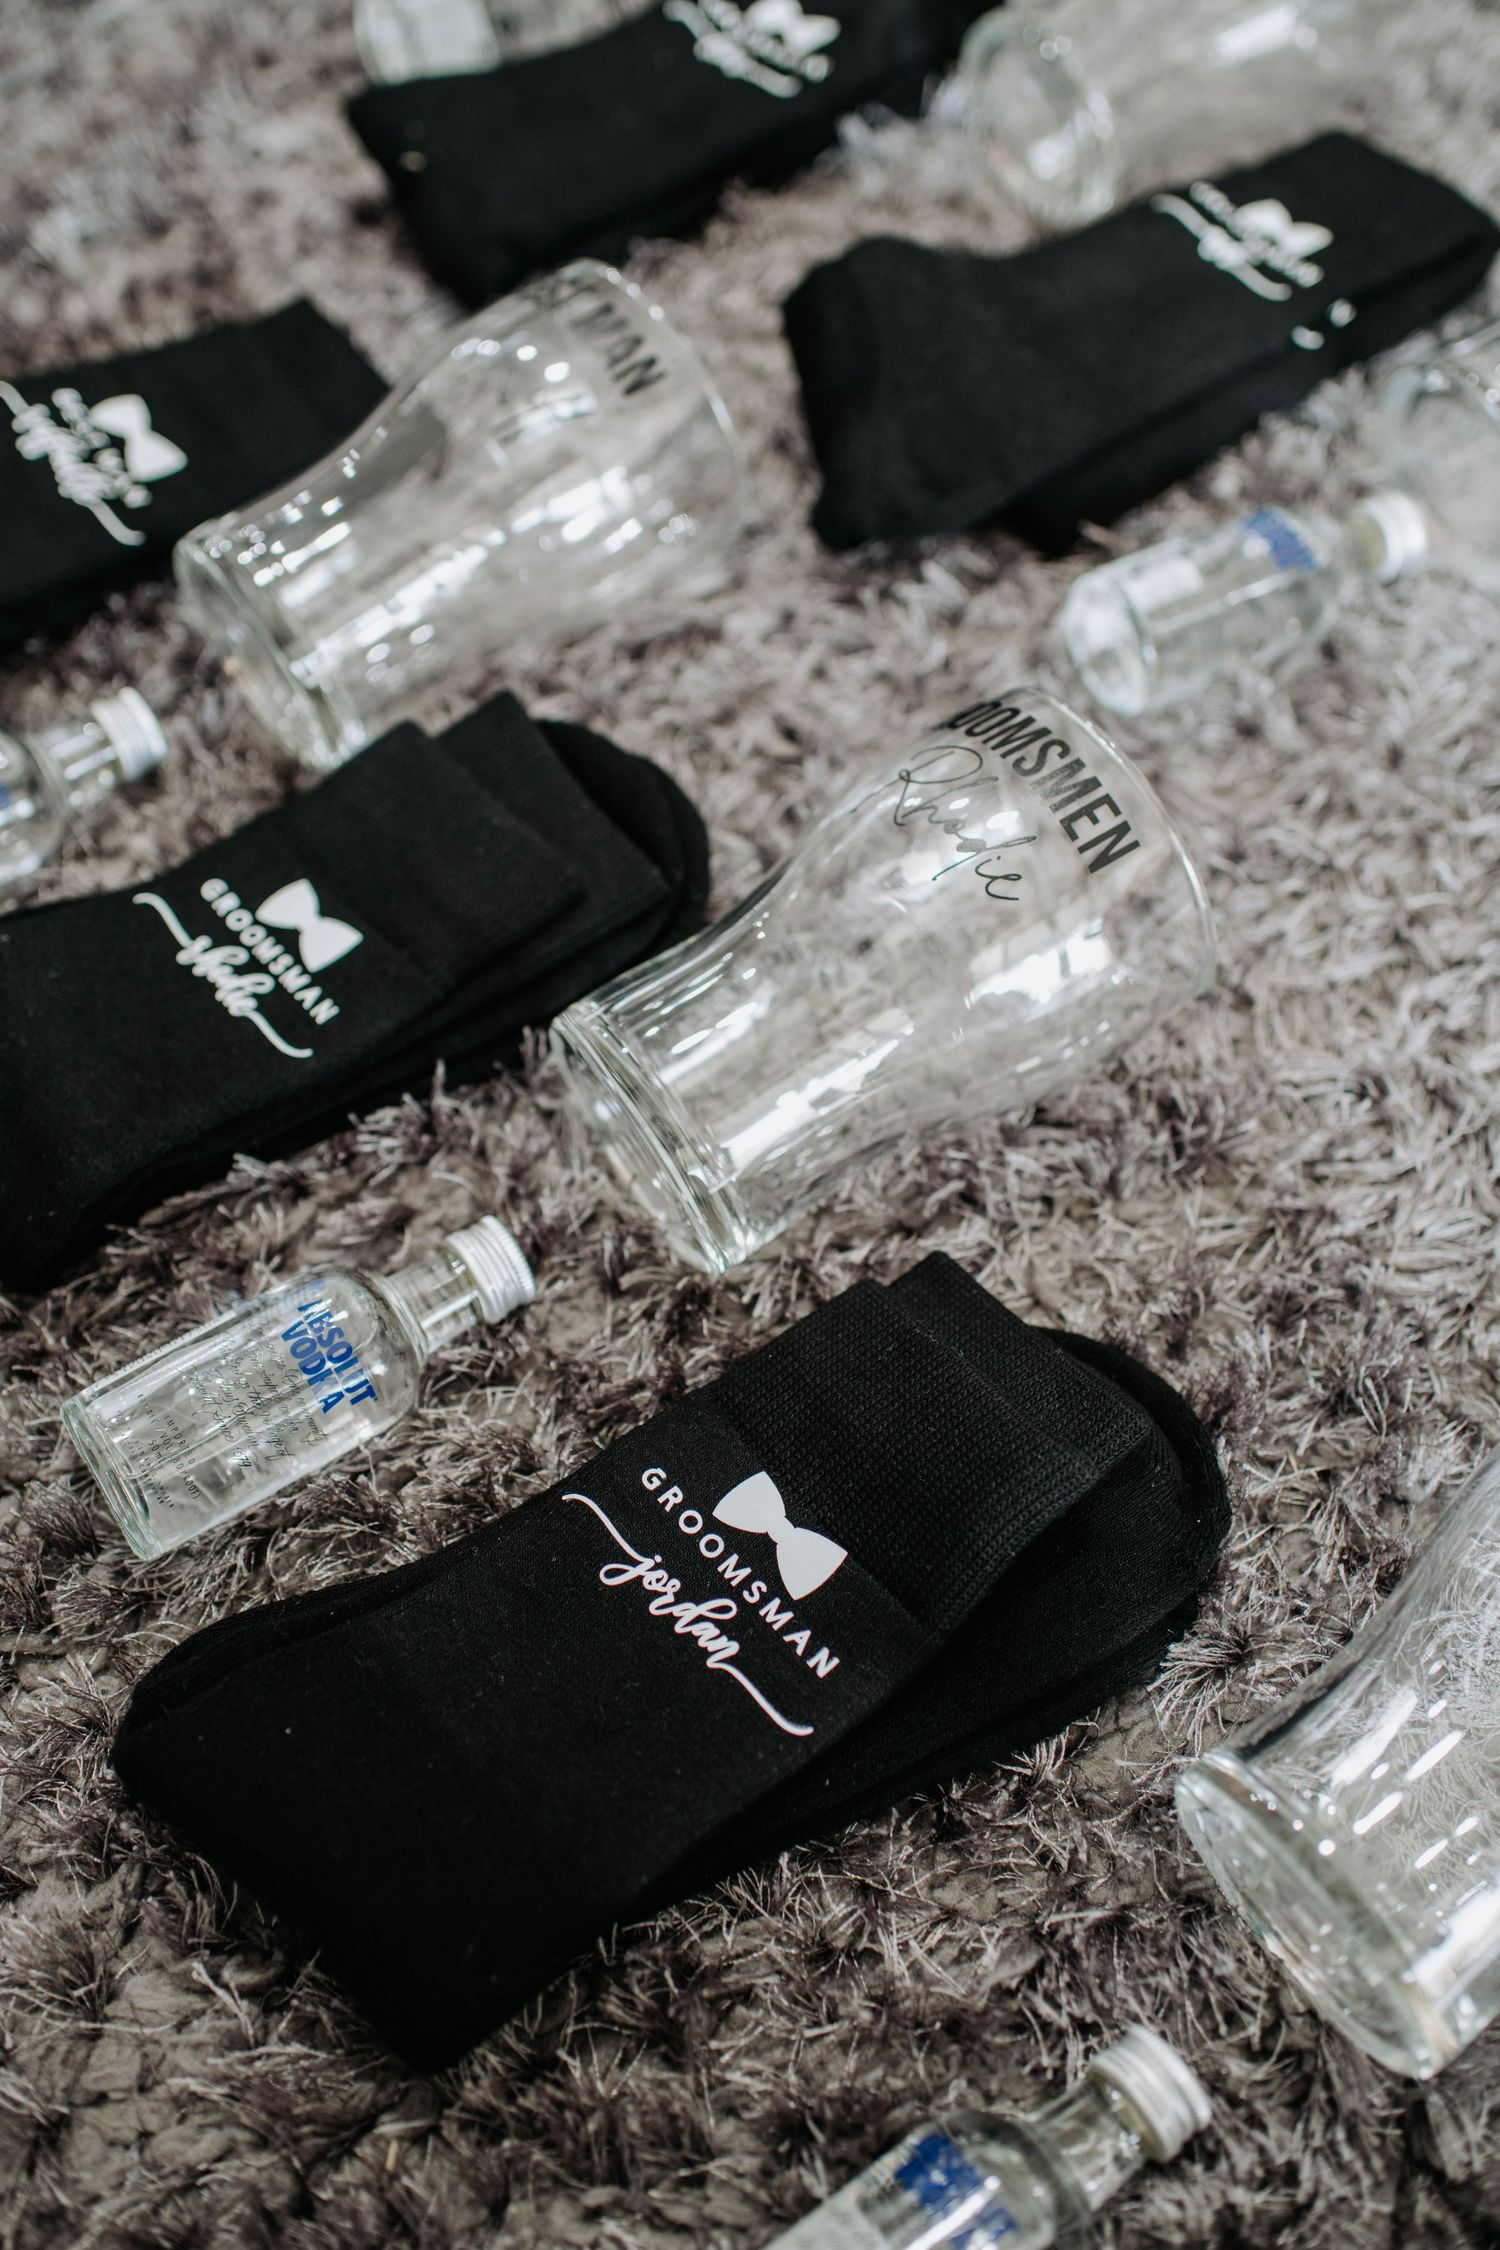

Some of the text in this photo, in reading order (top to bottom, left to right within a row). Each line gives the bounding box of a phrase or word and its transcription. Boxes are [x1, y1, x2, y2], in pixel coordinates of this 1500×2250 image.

[935, 700, 1141, 875] OOMSMEN
[200, 878, 340, 1026] GROOMSMAN
[280, 1318, 346, 1414] VODKA
[297, 1298, 378, 1406] ABSOLUT
[161, 1412, 198, 1466] IMPORTED
[561, 1493, 815, 1736] jordan
[641, 1467, 840, 1679] GROOMSMAN
